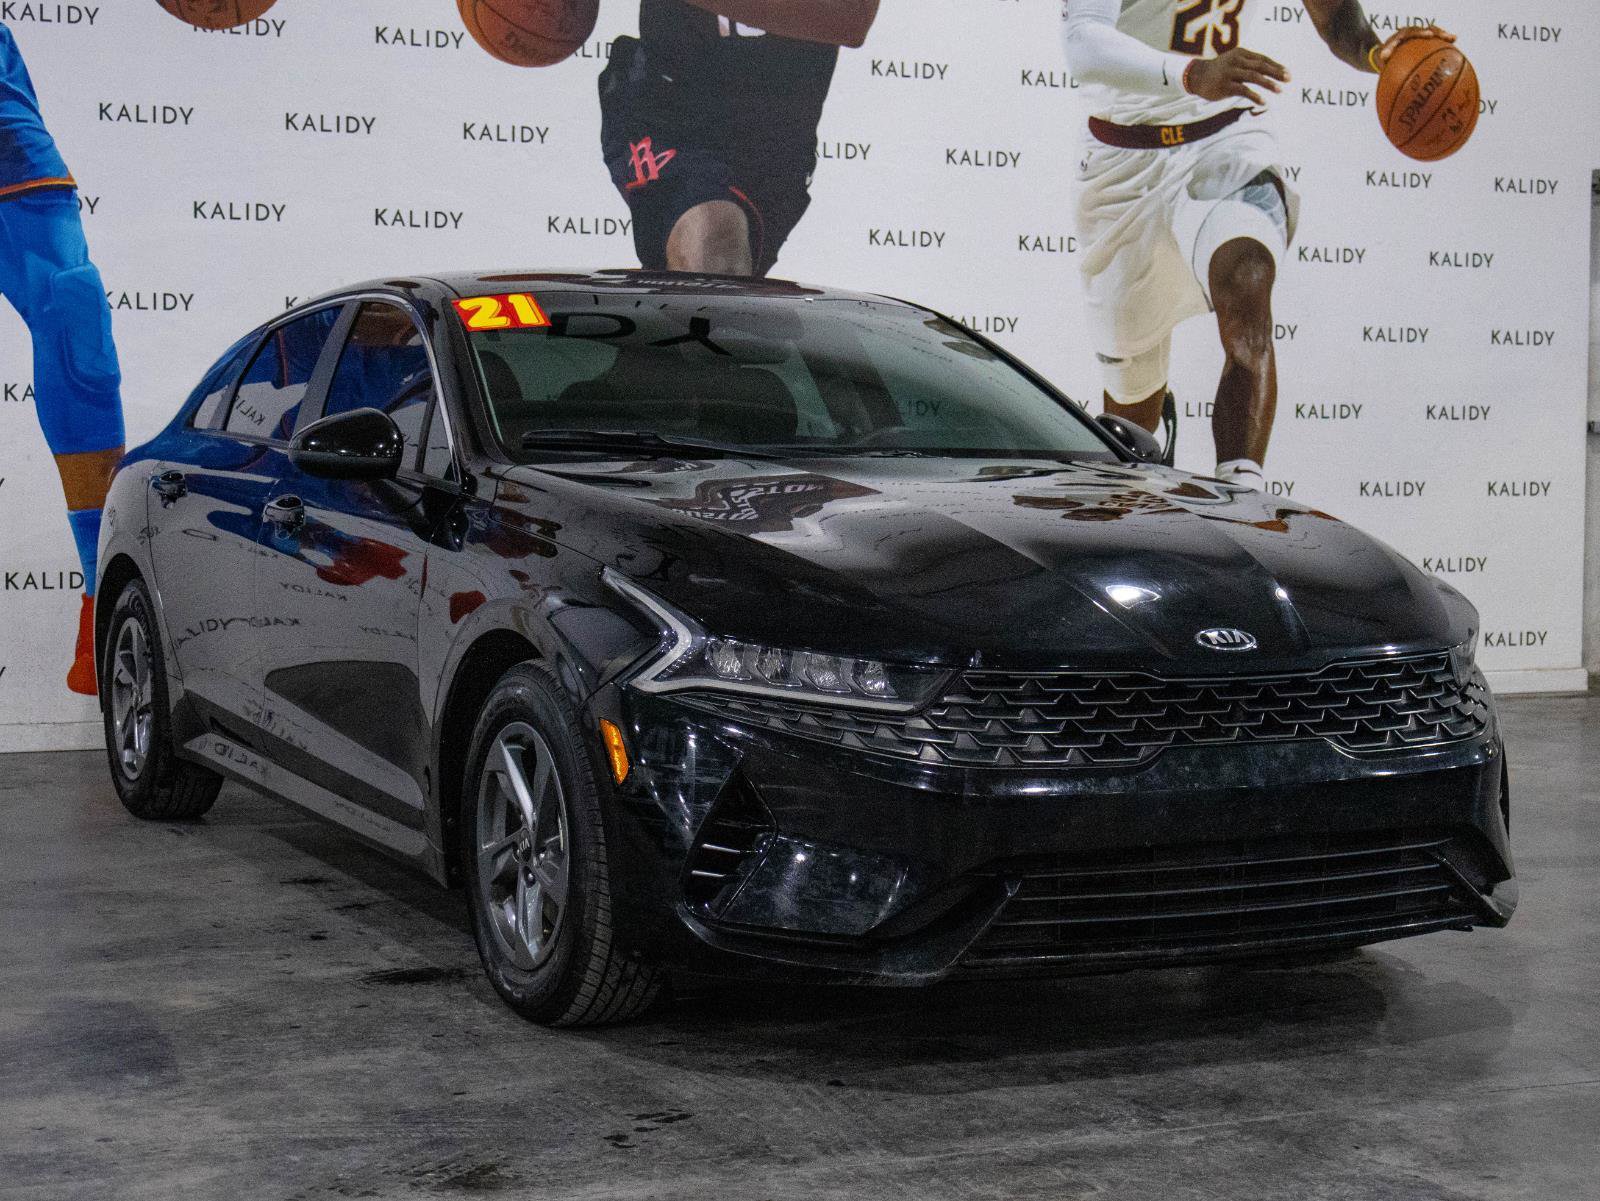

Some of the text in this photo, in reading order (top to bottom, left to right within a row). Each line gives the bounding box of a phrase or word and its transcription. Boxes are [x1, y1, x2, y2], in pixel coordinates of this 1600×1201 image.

[1, 2, 99, 25] KALIDY
[375, 25, 464, 49] KALIDY
[1498, 24, 1561, 42] KALIDY
[871, 60, 948, 80] KALIDY
[1021, 70, 1080, 88] KALID
[1302, 88, 1369, 107] KALIDY
[99, 103, 194, 125] KALIDY
[285, 113, 376, 135] KALIDY
[463, 122, 549, 145] KALIDY
[1161, 127, 1184, 145] CLE
[814, 141, 871, 160] LIDY
[946, 149, 1020, 168] KALIDY
[1366, 171, 1432, 188] KALIDY
[1495, 177, 1558, 194] KALIDY
[193, 201, 286, 222] KALIDY
[374, 208, 463, 230] KALIDY
[547, 215, 632, 236] KALIDY
[869, 229, 945, 248] KALIDY
[1019, 235, 1076, 253] KALID
[1298, 246, 1365, 263] KALIDY
[1429, 251, 1494, 268] KALIDY
[460, 294, 546, 328] 21
[950, 315, 1018, 333] ALIDY
[1363, 326, 1428, 344] KALIDY
[1491, 330, 1555, 346] KALIDY
[1295, 403, 1362, 420] KALIDY
[1426, 404, 1490, 421] KALIDY
[1359, 481, 1425, 497] KALIDY
[1488, 481, 1551, 497] KALIDY
[1423, 557, 1487, 573] KALIDY
[5, 571, 85, 590] KALID
[1204, 630, 1252, 647] KIA
[1484, 631, 1548, 647] KALIDY
